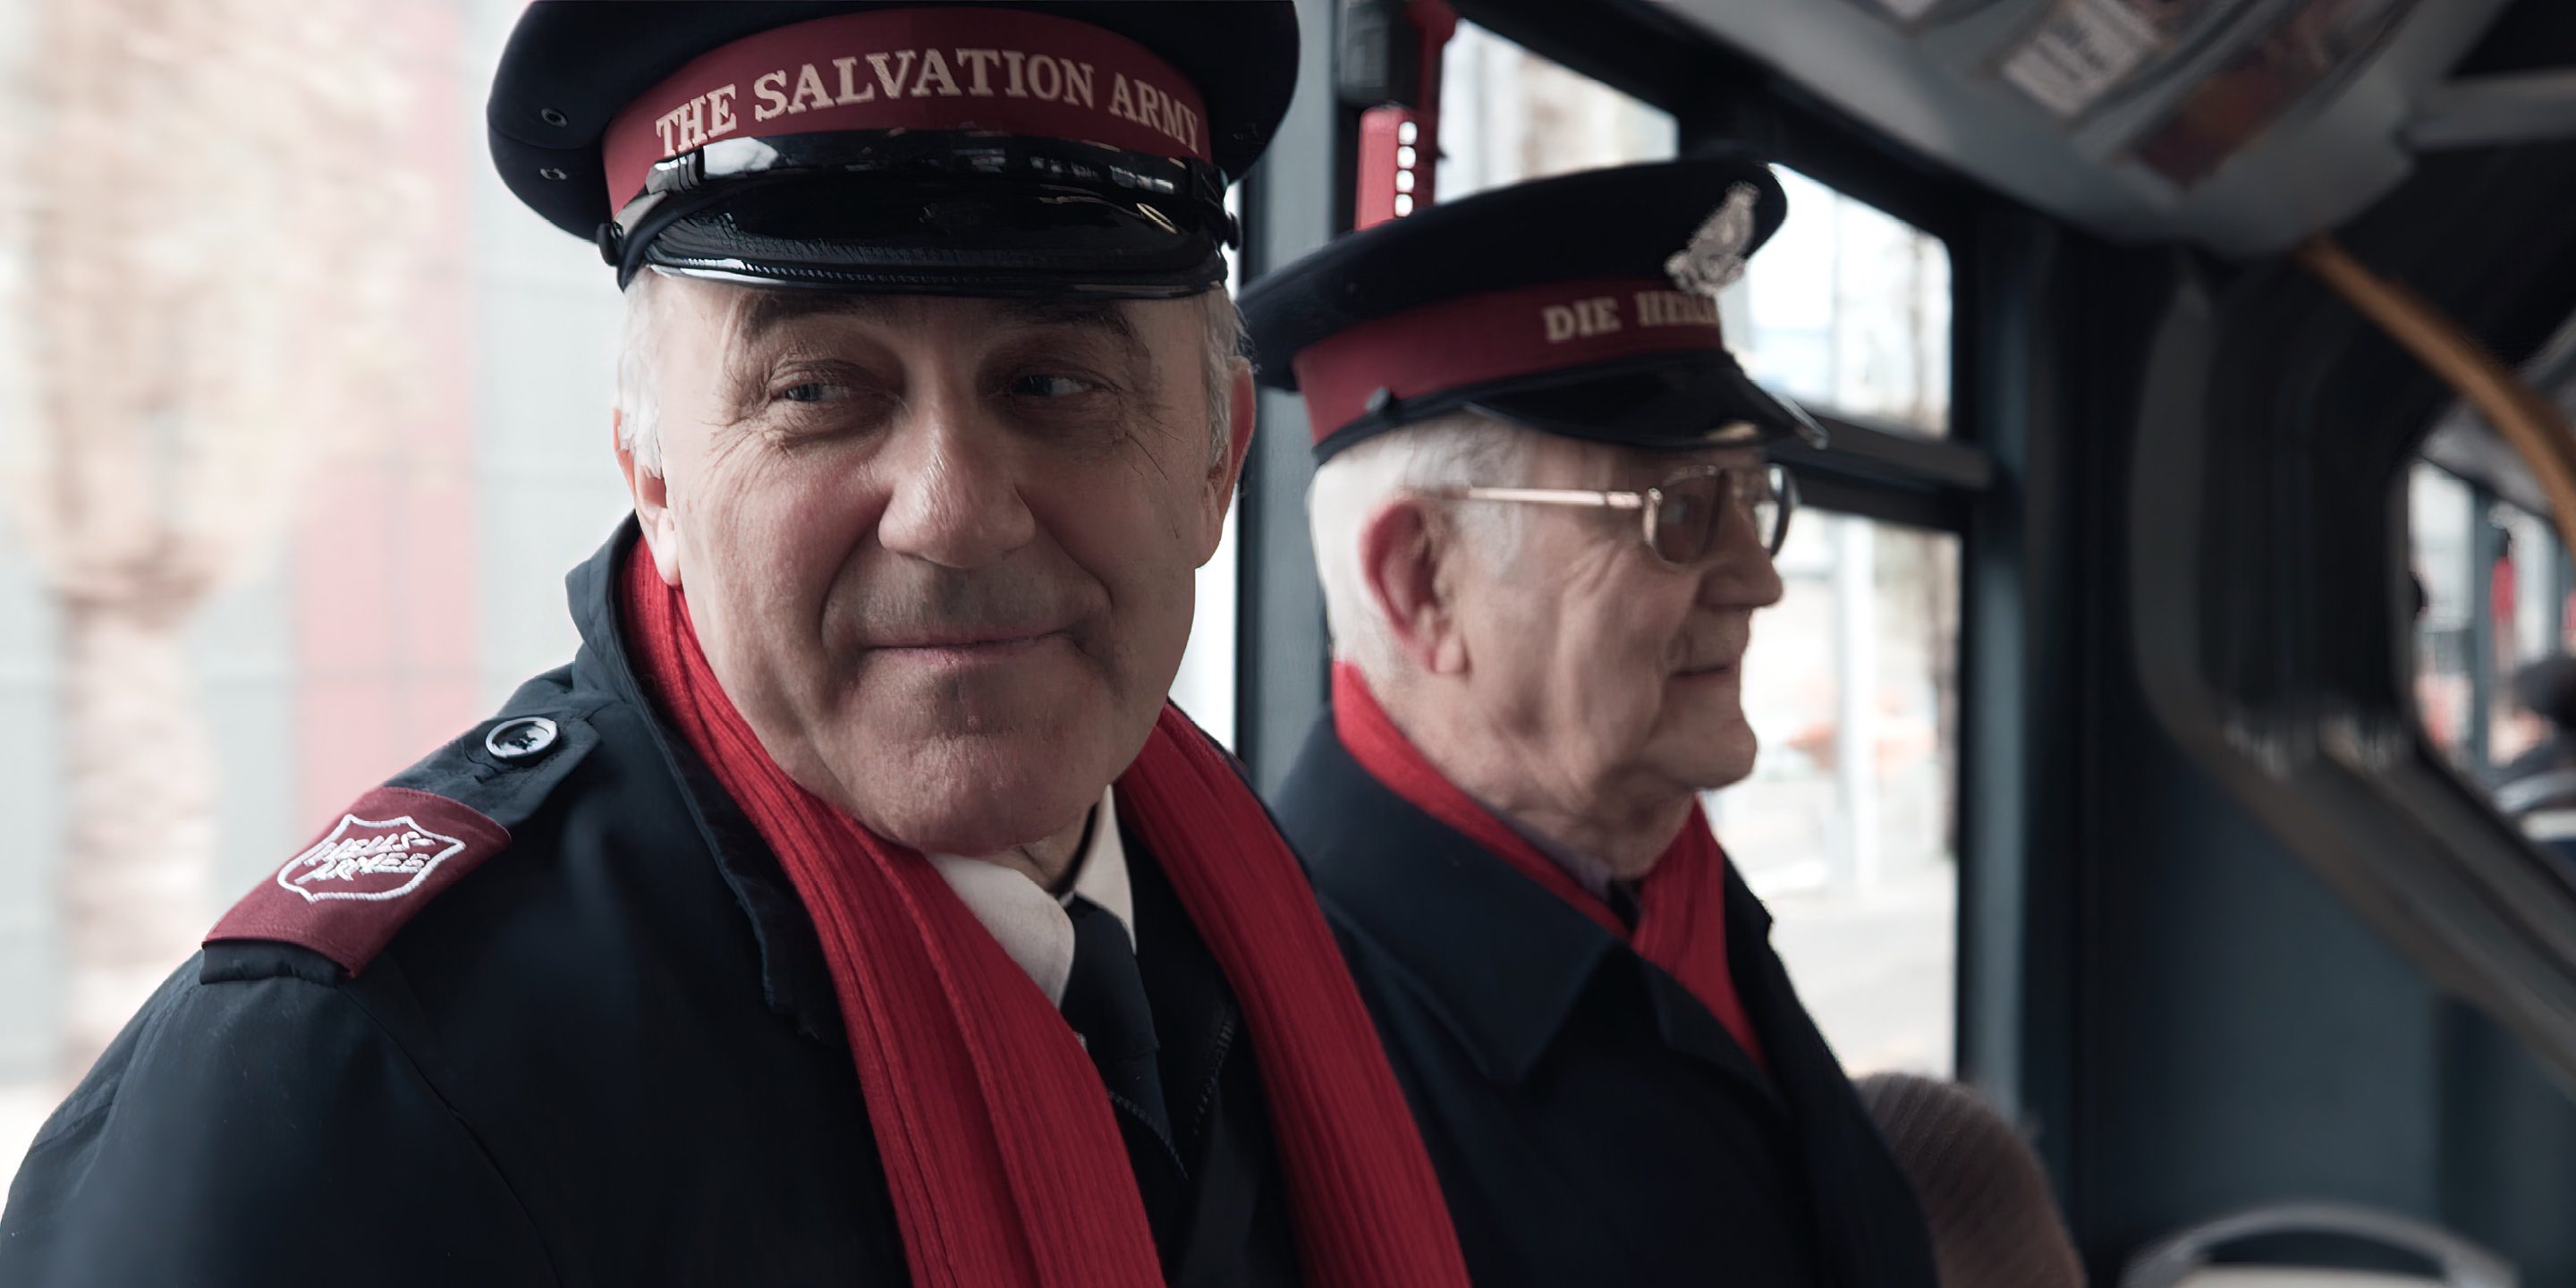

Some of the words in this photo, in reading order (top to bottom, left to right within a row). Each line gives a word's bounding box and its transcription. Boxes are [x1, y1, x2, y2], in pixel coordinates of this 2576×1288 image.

[656, 83, 737, 157] THE
[754, 47, 1095, 123] SALVATION
[1108, 72, 1199, 155] ARMY
[1542, 295, 1622, 343] DIE
